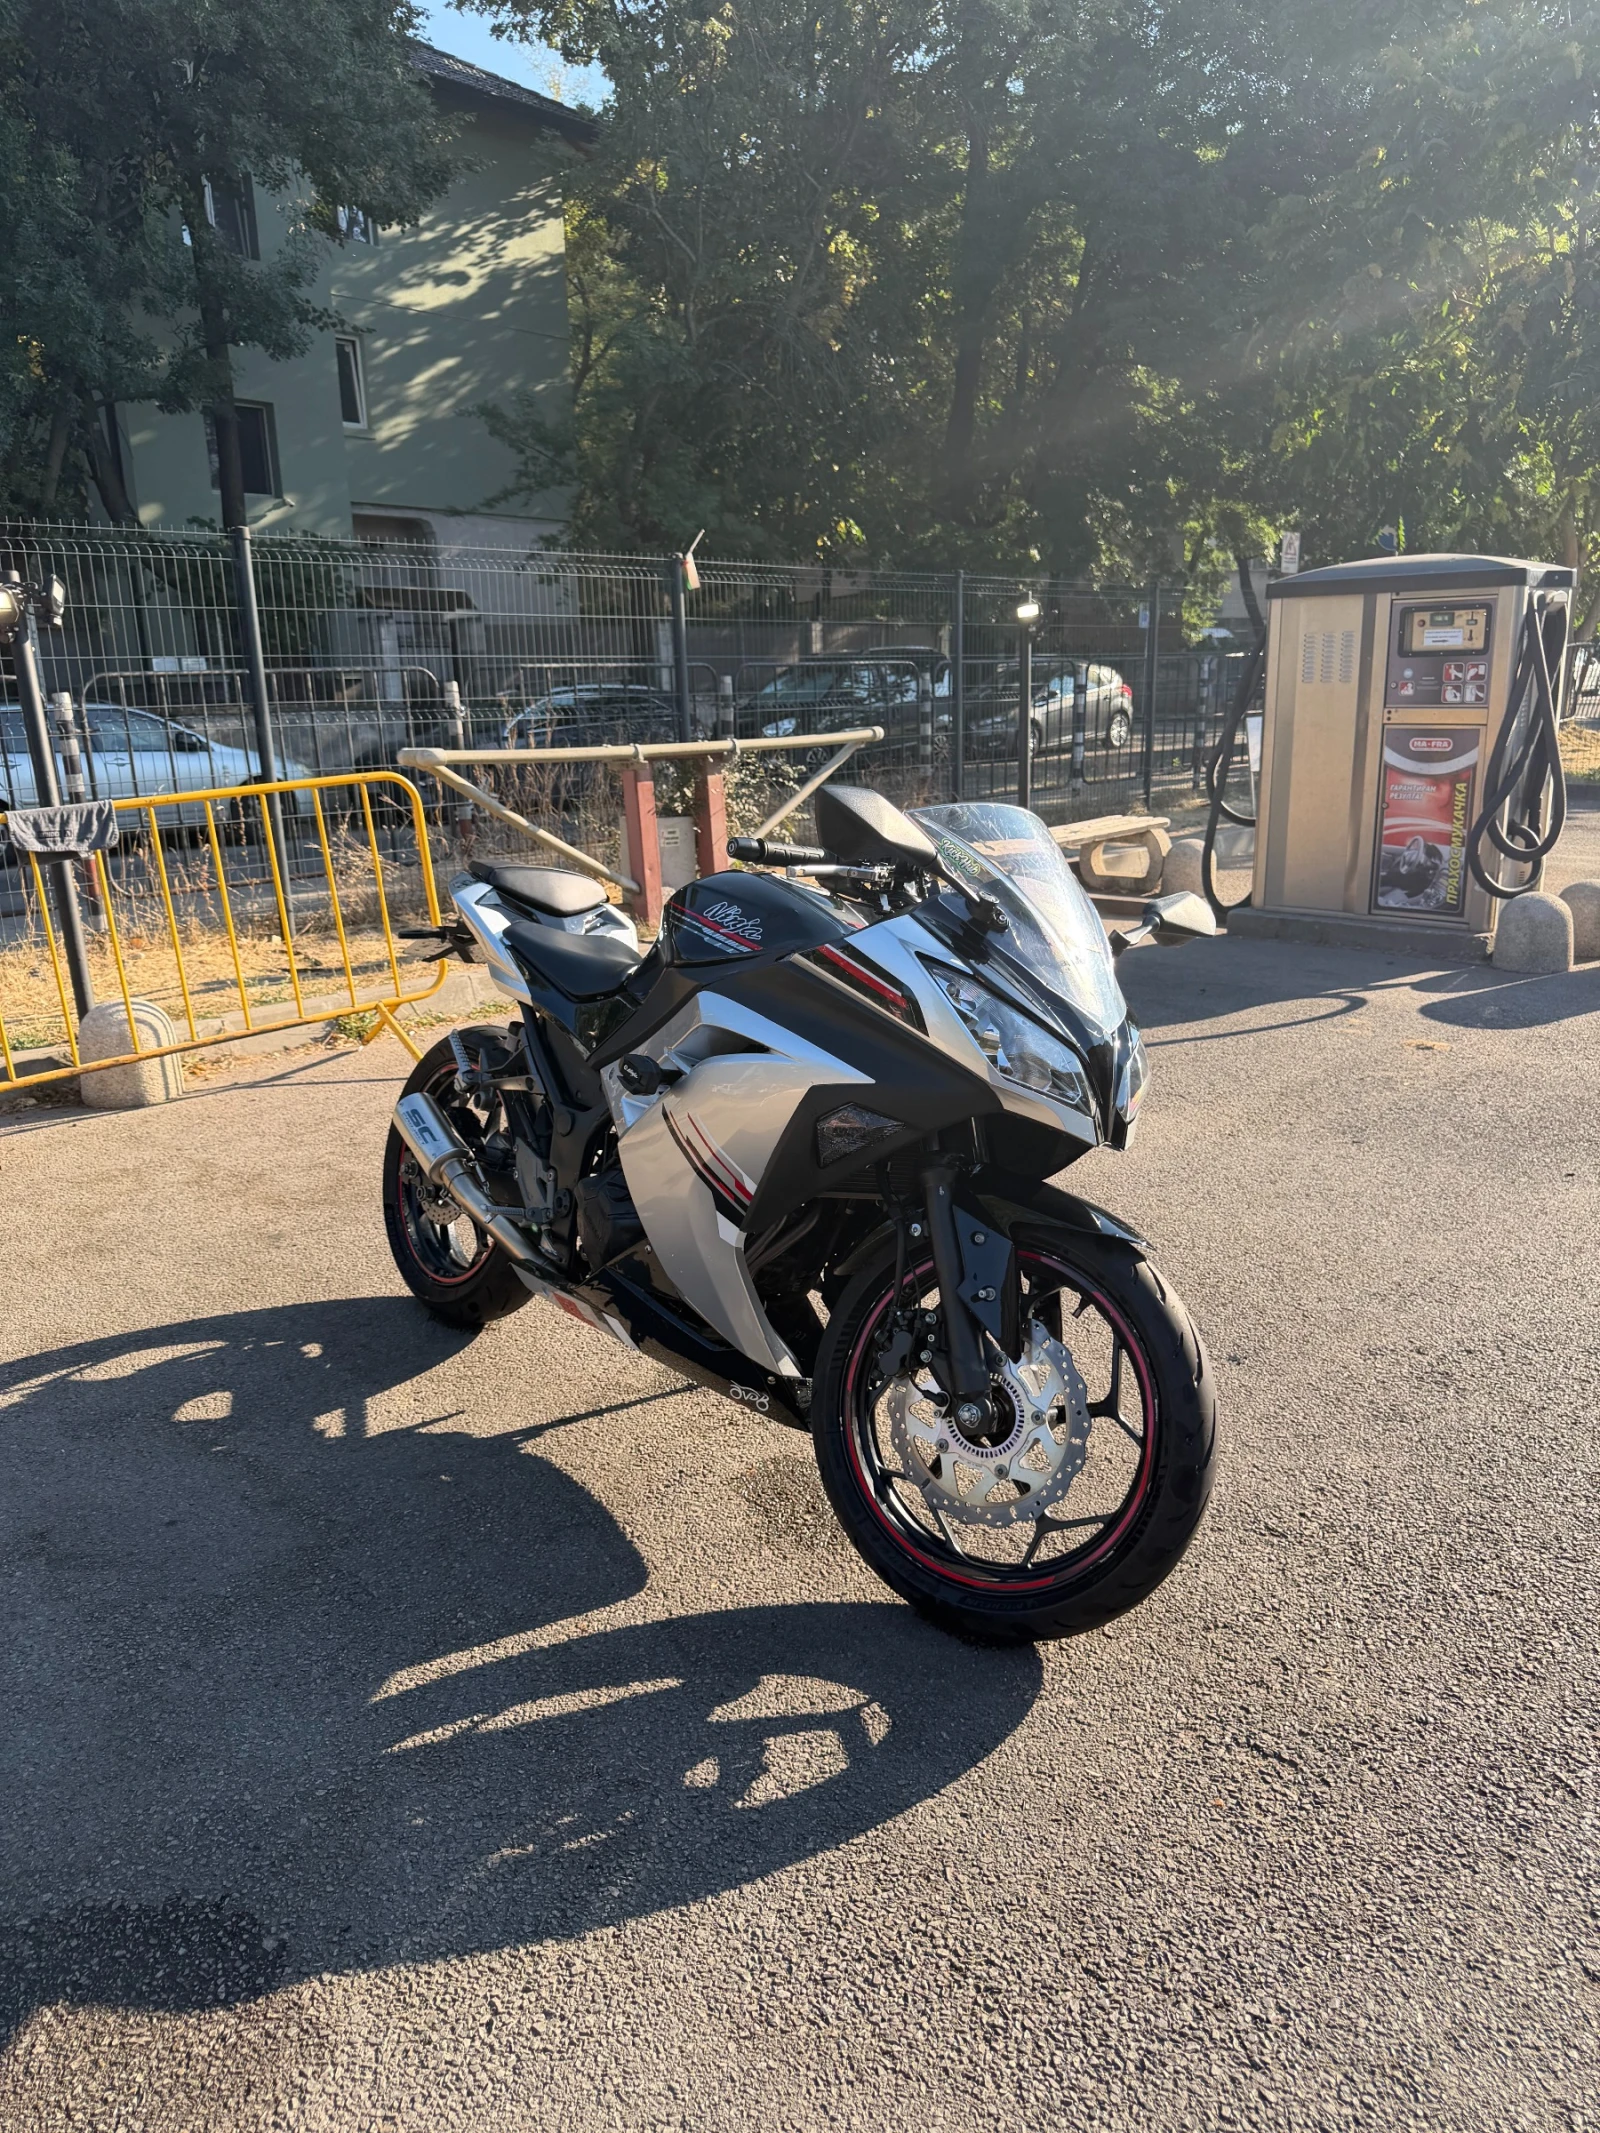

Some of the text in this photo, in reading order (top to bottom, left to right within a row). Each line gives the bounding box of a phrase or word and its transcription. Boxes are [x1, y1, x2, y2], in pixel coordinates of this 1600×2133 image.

[1446, 782, 1468, 905] ПРАХОСМУКАЧКА
[703, 901, 763, 940] Ninja
[405, 1108, 440, 1144] SC
